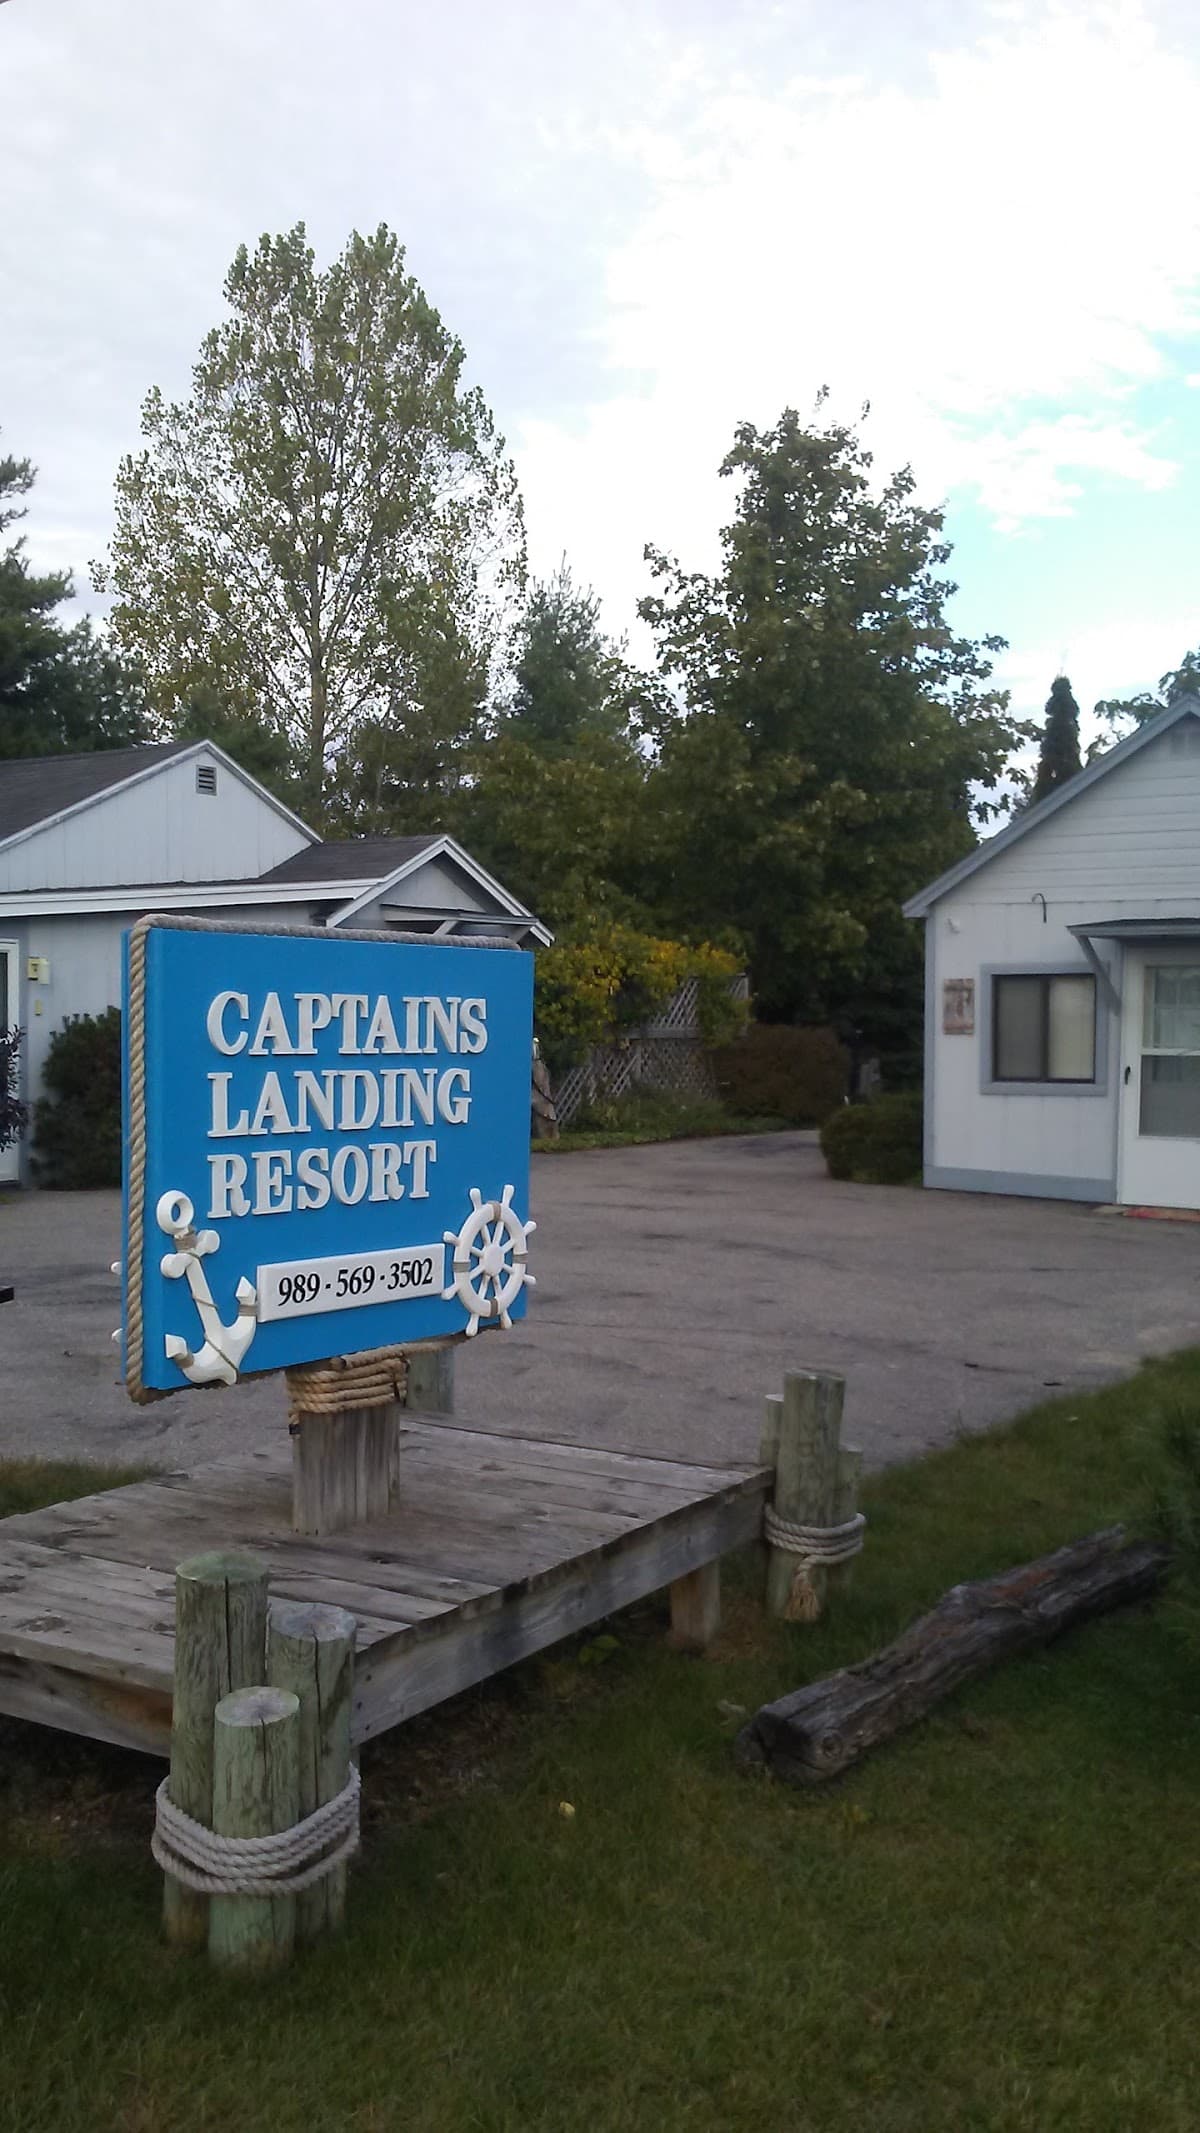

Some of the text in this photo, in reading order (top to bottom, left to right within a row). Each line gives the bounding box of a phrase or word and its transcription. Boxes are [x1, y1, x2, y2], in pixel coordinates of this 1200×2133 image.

[206, 991, 487, 1056] CAPTAINS
[206, 1068, 472, 1138] LANDING
[206, 1141, 437, 1219] RESORT
